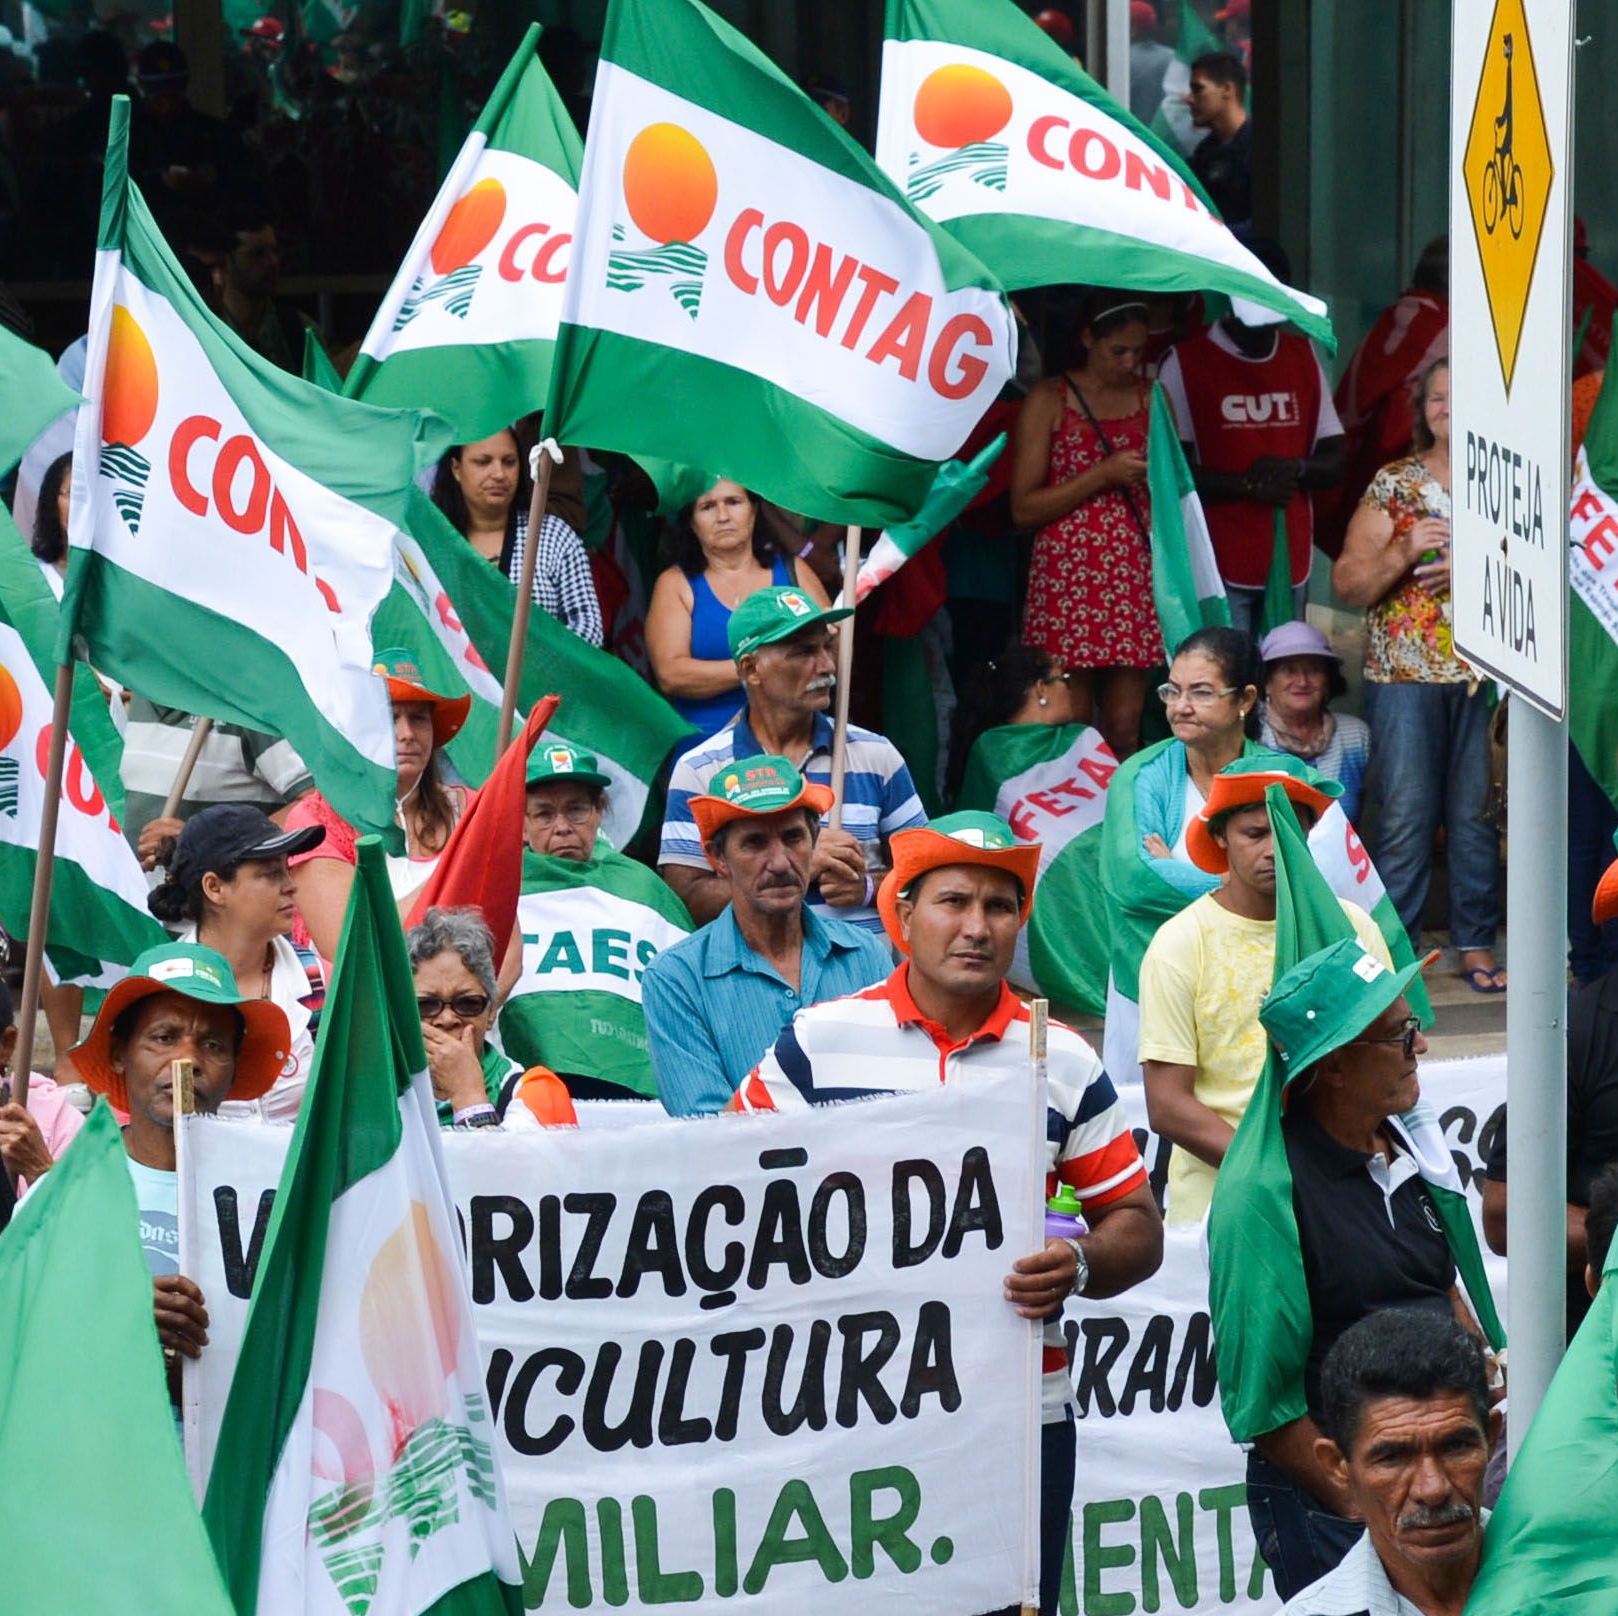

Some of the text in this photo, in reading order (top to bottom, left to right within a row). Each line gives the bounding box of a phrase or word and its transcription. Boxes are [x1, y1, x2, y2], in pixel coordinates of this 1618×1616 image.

[1027, 115, 1223, 225] CONT
[725, 208, 993, 401] CONTAG
[1221, 392, 1290, 422] CUT
[168, 415, 342, 613] CON
[1466, 430, 1544, 550] PROTEJA
[1482, 554, 1494, 636] A
[1495, 560, 1538, 663] VIDA
[1008, 743, 1119, 843] FETA
[213, 1146, 864, 1310] VRIZAÇÃO
[892, 1145, 1003, 1269] DA
